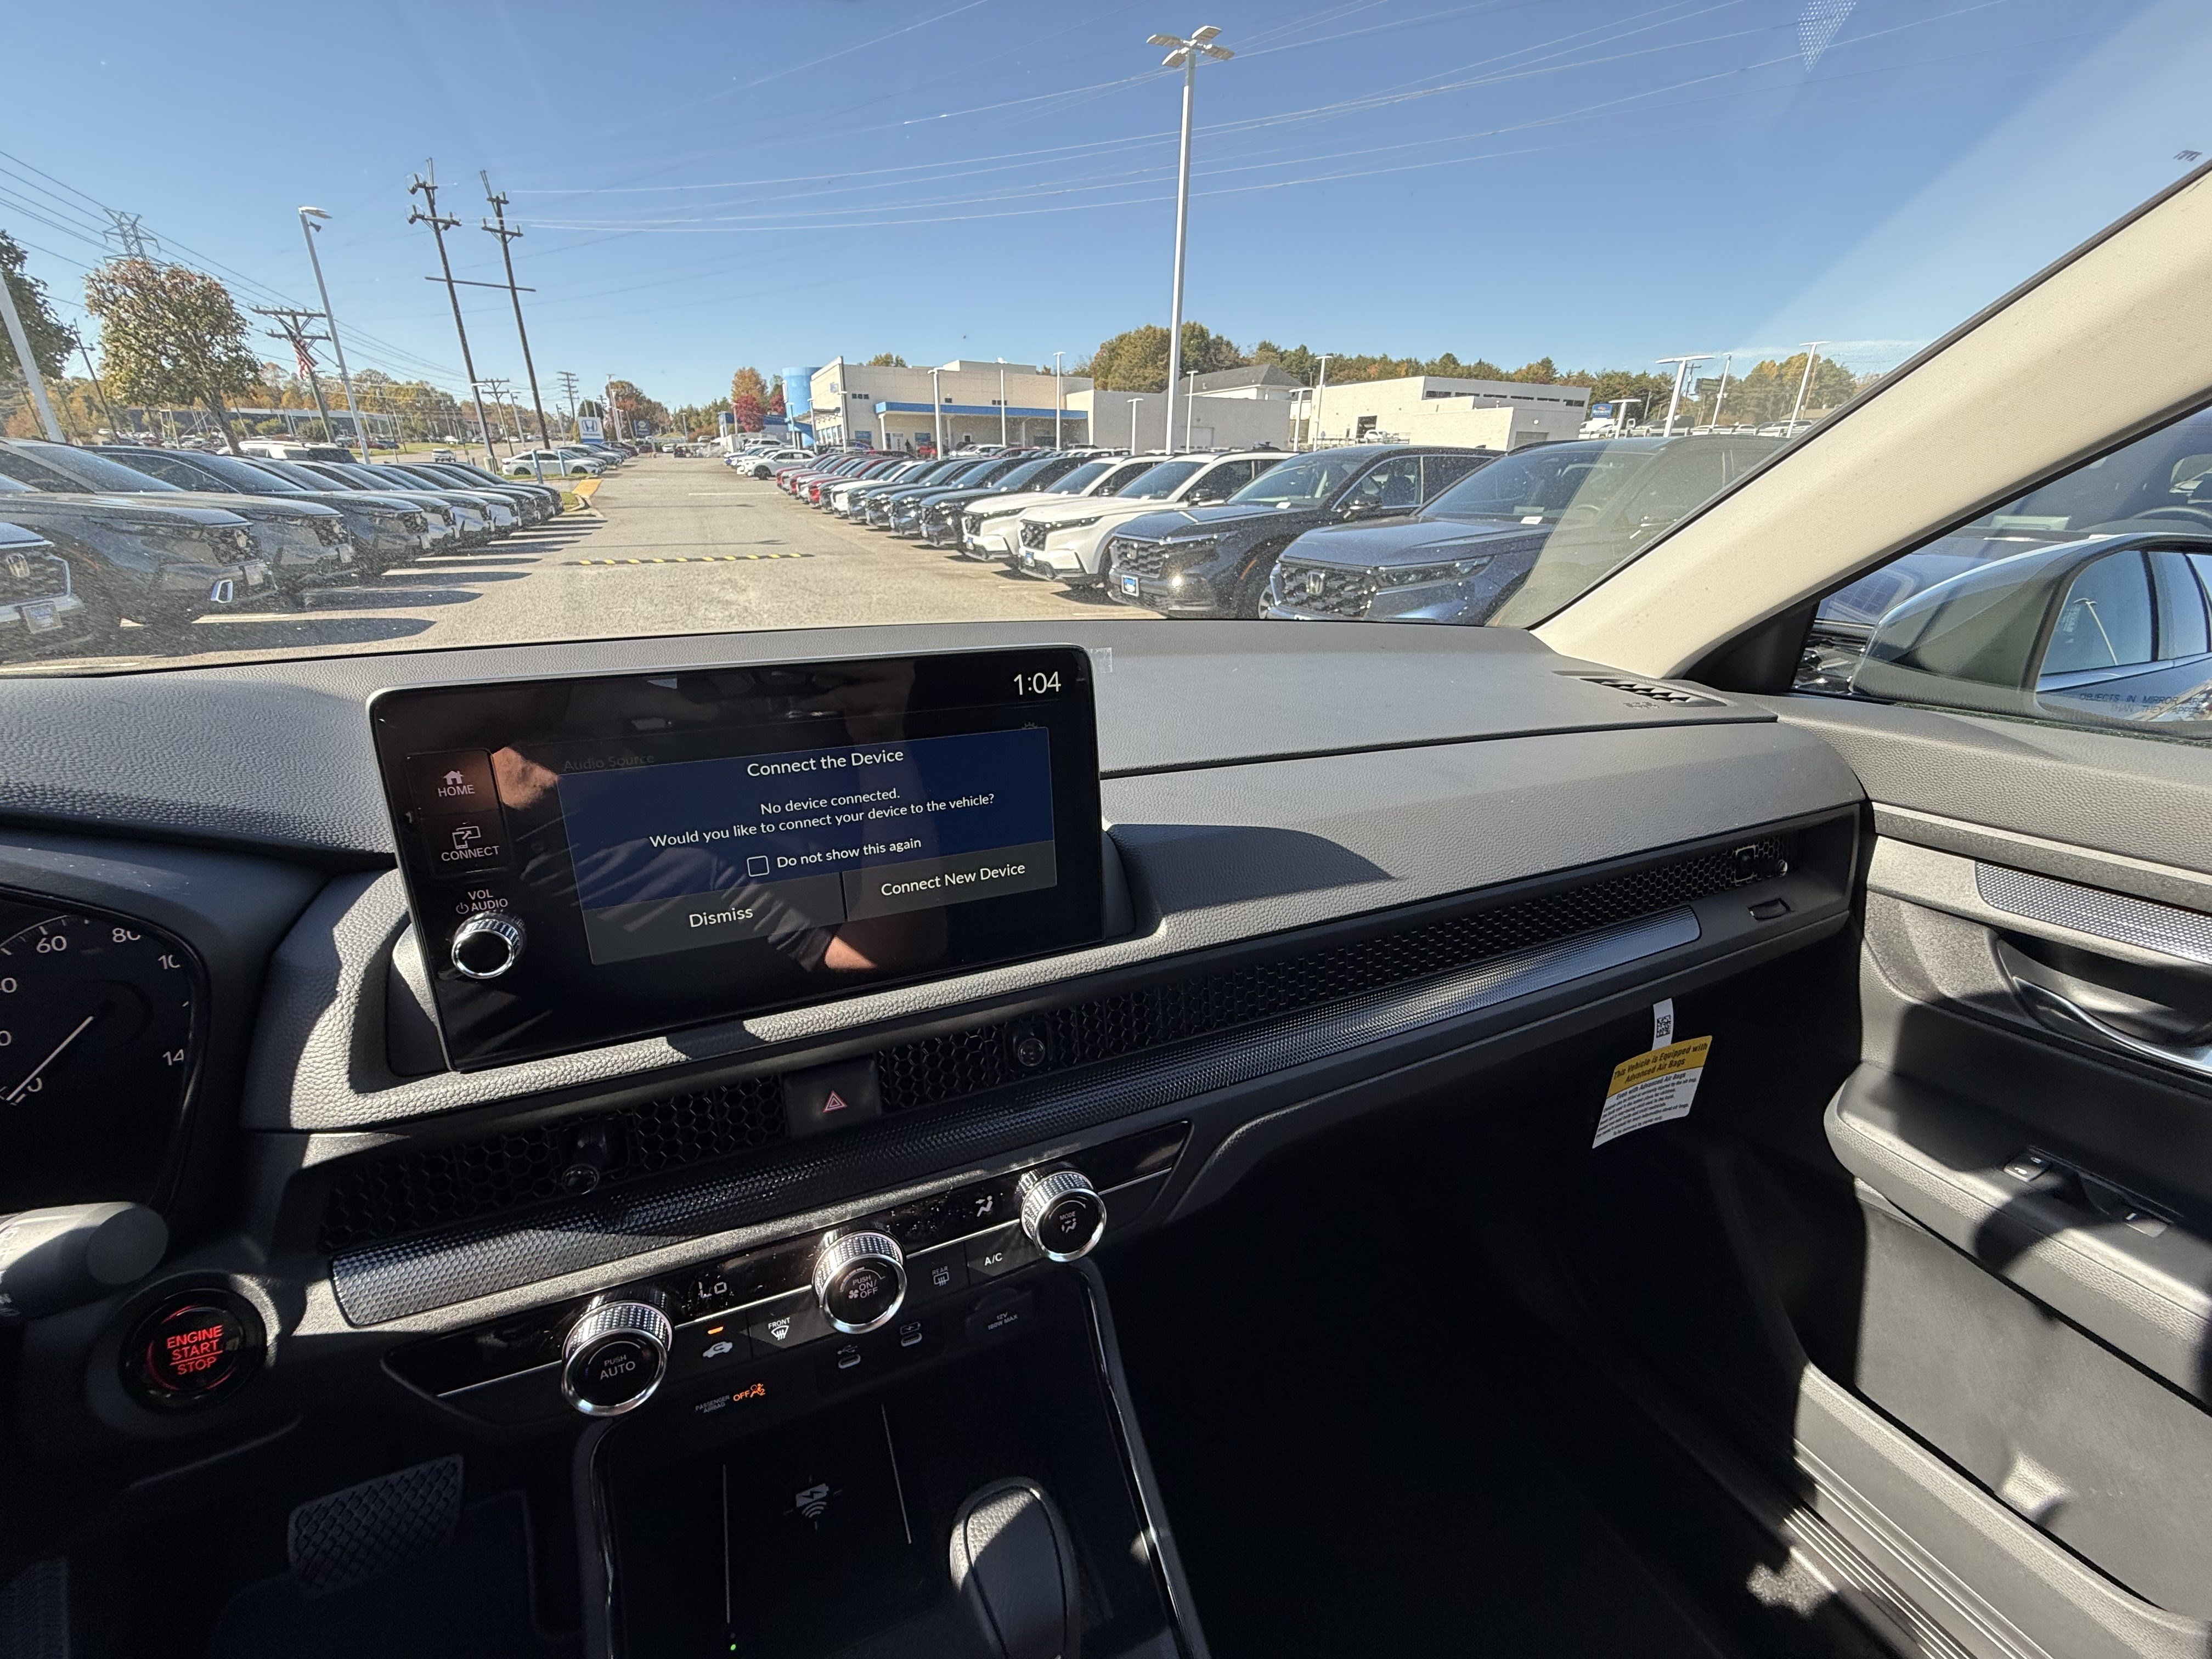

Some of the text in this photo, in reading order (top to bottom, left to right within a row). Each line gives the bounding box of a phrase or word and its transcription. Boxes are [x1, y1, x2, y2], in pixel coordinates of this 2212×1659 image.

[1014, 672, 1061, 695] 1:04
[747, 749, 904, 776] Connect the Device
[438, 785, 475, 797] HOME
[761, 788, 900, 815] No device connected.
[650, 793, 995, 847] Would you like to connect your device to the vehicle?
[441, 845, 500, 862] CONNECT
[777, 838, 922, 868] Do not show this again
[881, 864, 1025, 896] Connect New Device
[468, 889, 494, 900] VOL
[471, 898, 508, 912] AUDIO
[689, 907, 753, 928] Dismiss
[36, 935, 67, 953] 60
[1613, 1043, 1708, 1079] This Vehicle is Equipped with
[1624, 1058, 1685, 1084] Advanced Air Bags
[1059, 1211, 1076, 1220] MODE
[985, 1252, 1003, 1266] A/C
[853, 1274, 871, 1285] PUSH
[933, 1266, 948, 1275] REAR
[859, 1279, 877, 1291] ON/
[860, 1286, 878, 1298] OFF
[768, 1317, 790, 1329] FRONT
[167, 1325, 223, 1348] ENGINE
[172, 1339, 219, 1360] START
[177, 1356, 217, 1375] STOP
[604, 1354, 627, 1367] PUSH
[600, 1361, 636, 1380] AUTO
[695, 1390, 750, 1412] PASSENGER OFF
